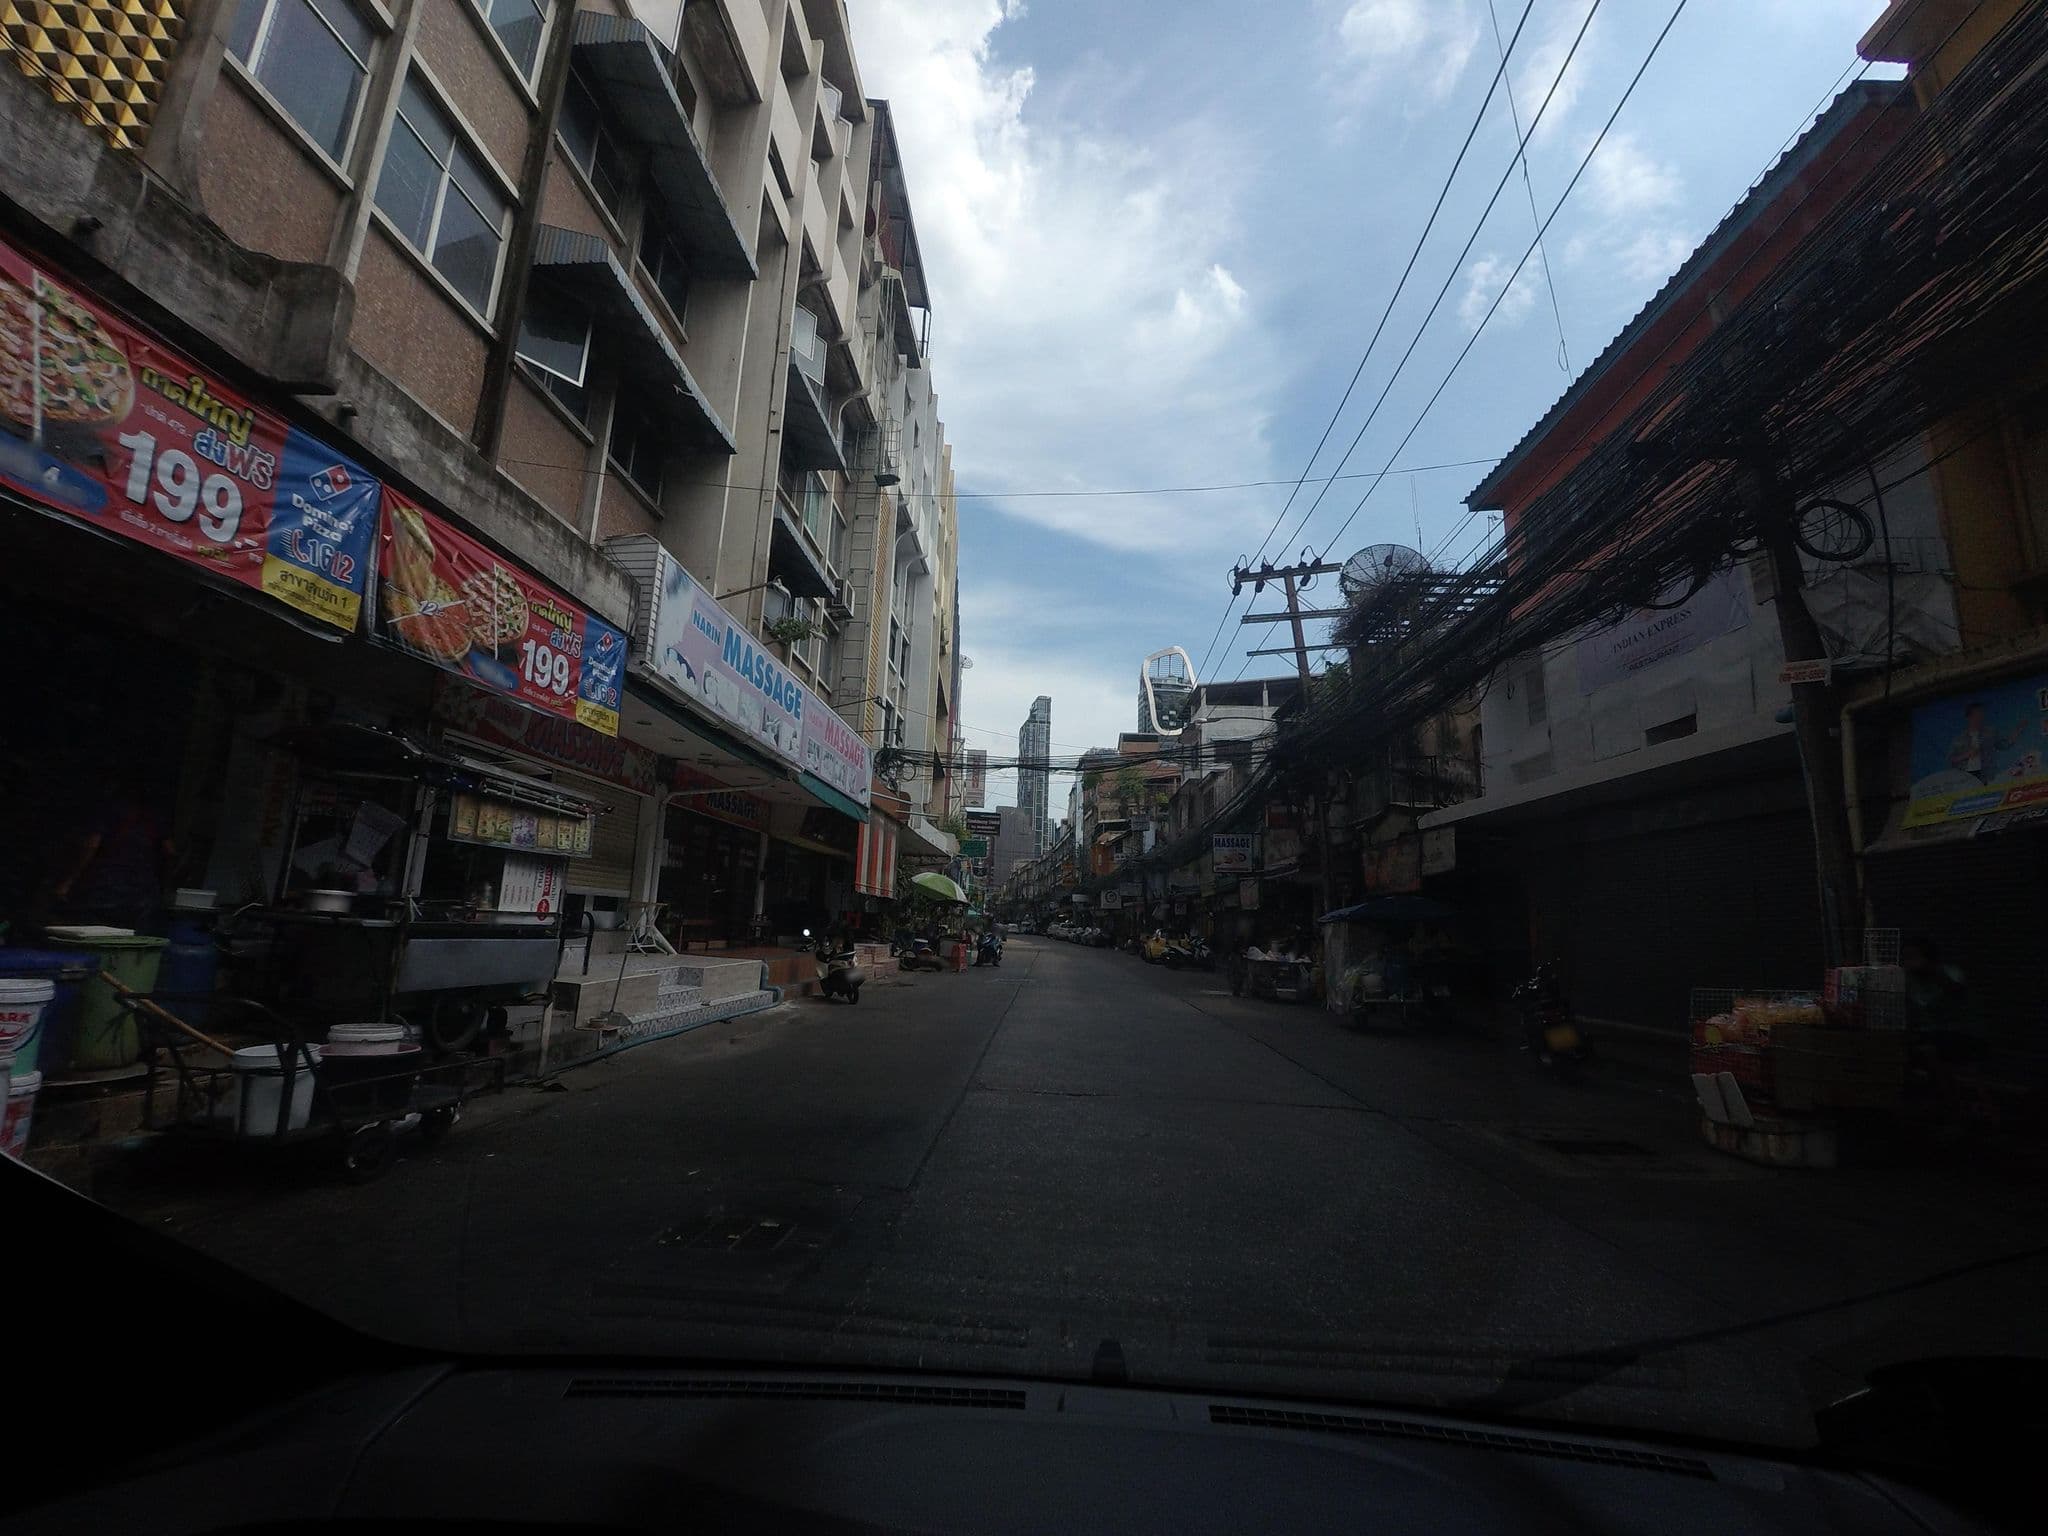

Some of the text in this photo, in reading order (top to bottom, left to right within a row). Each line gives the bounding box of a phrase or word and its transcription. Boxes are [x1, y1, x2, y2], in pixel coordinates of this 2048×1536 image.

[194, 427, 275, 490] ส่งฟรี
[303, 515, 343, 543] Pizza
[693, 610, 802, 720] NARIN MASSAGE
[824, 717, 865, 770] MASSAGE
[1214, 838, 1250, 848] MASSAGE
